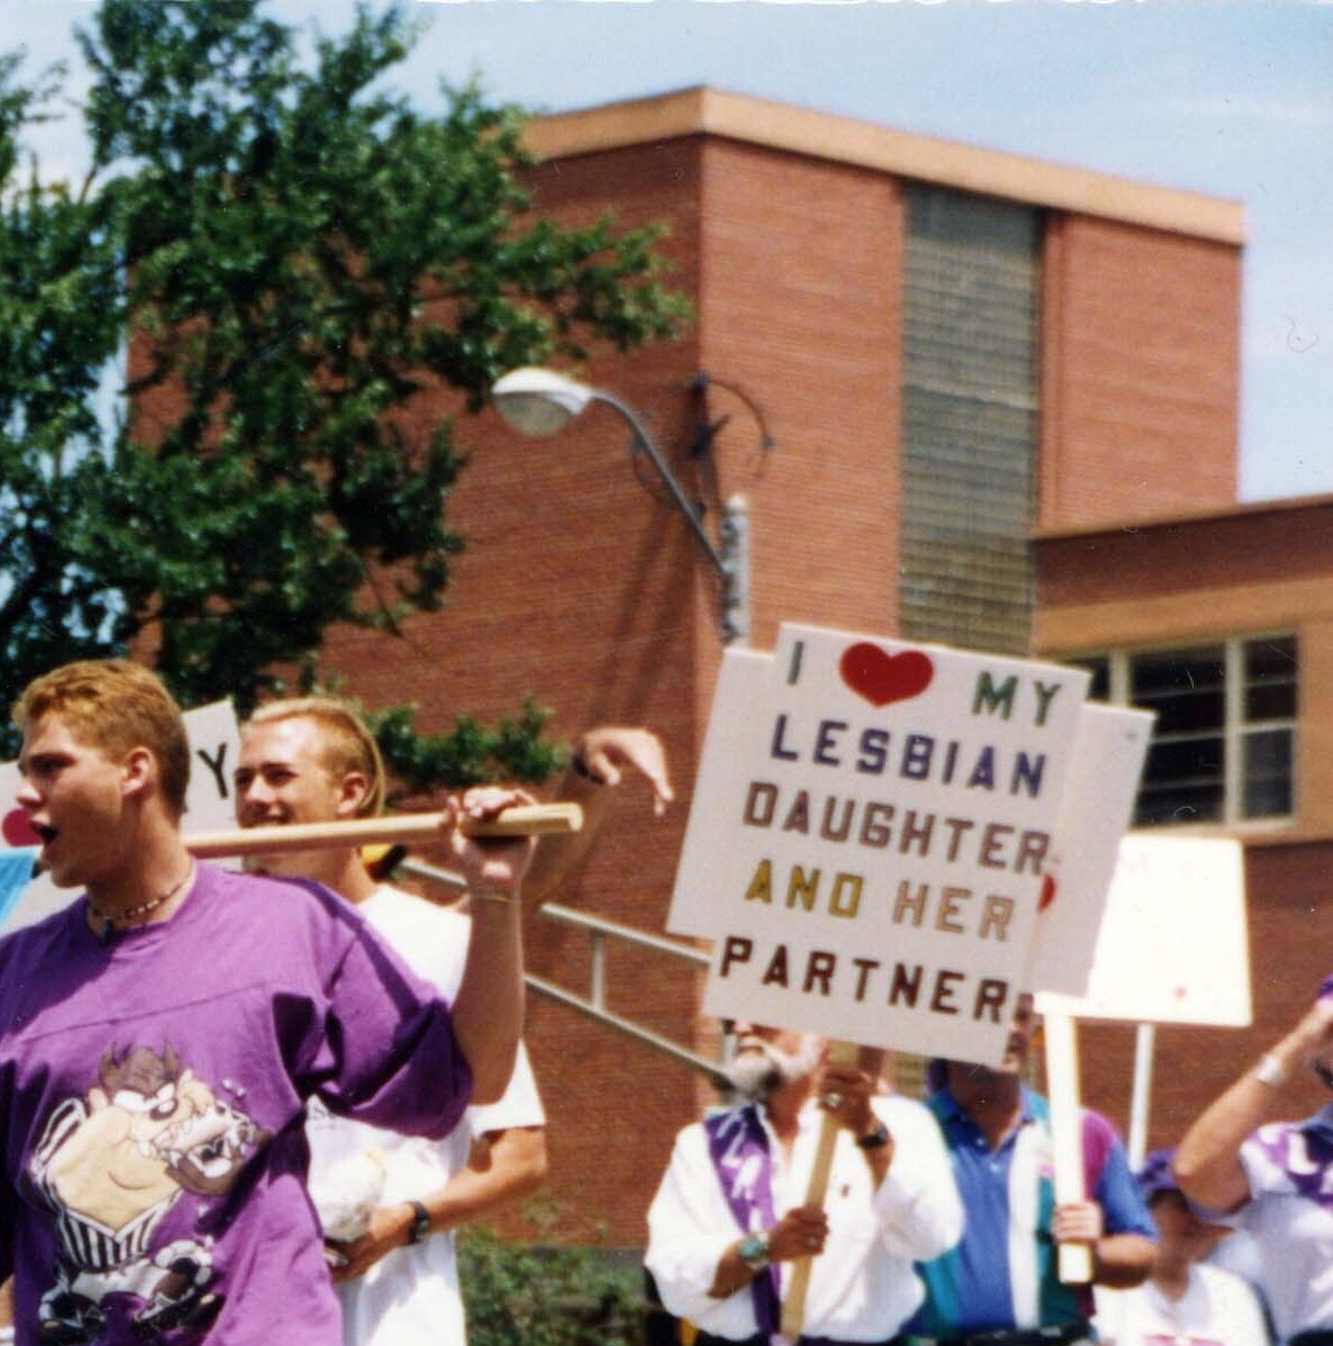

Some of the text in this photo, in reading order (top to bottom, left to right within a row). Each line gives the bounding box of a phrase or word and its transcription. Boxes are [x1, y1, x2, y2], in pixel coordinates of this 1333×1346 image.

[786, 640, 1064, 728] I MY
[771, 714, 1047, 799] LESBIAN
[742, 781, 1053, 877] DAUGHTER
[744, 859, 1016, 943] AND HER
[720, 936, 1011, 1026] PARTNER
